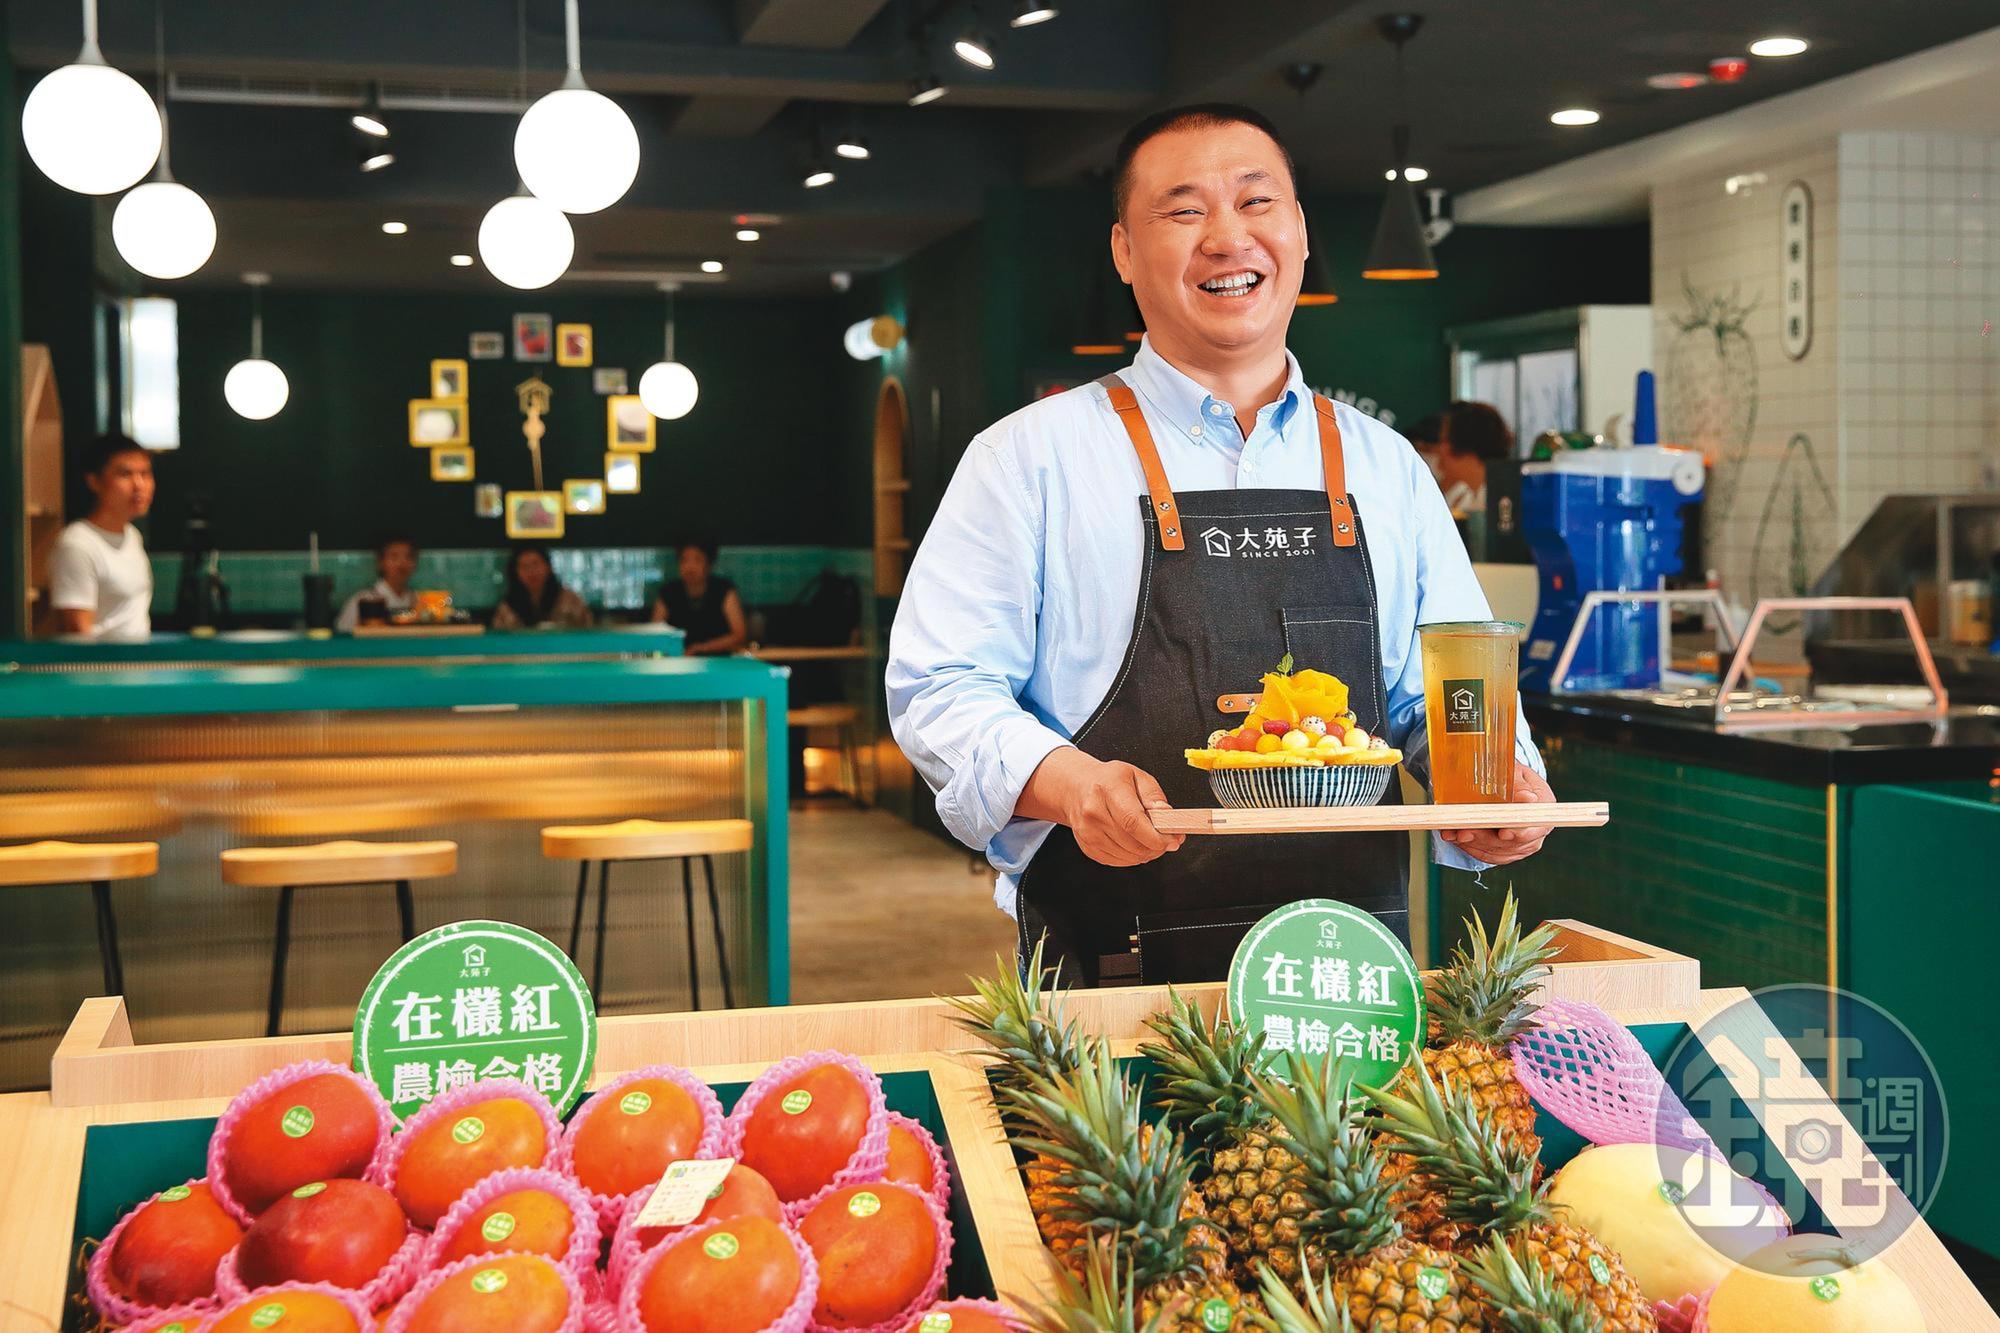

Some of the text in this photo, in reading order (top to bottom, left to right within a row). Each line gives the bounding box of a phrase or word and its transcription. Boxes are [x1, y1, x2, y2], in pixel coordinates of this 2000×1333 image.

[1236, 527, 1317, 551] 大苑子
[1286, 549, 1316, 557] 2001
[1449, 710, 1480, 721] 大苑子
[1262, 951, 1398, 1006] 在欉紅
[391, 983, 561, 1042] 在欉紅
[1263, 1014, 1401, 1063] 農檢合格
